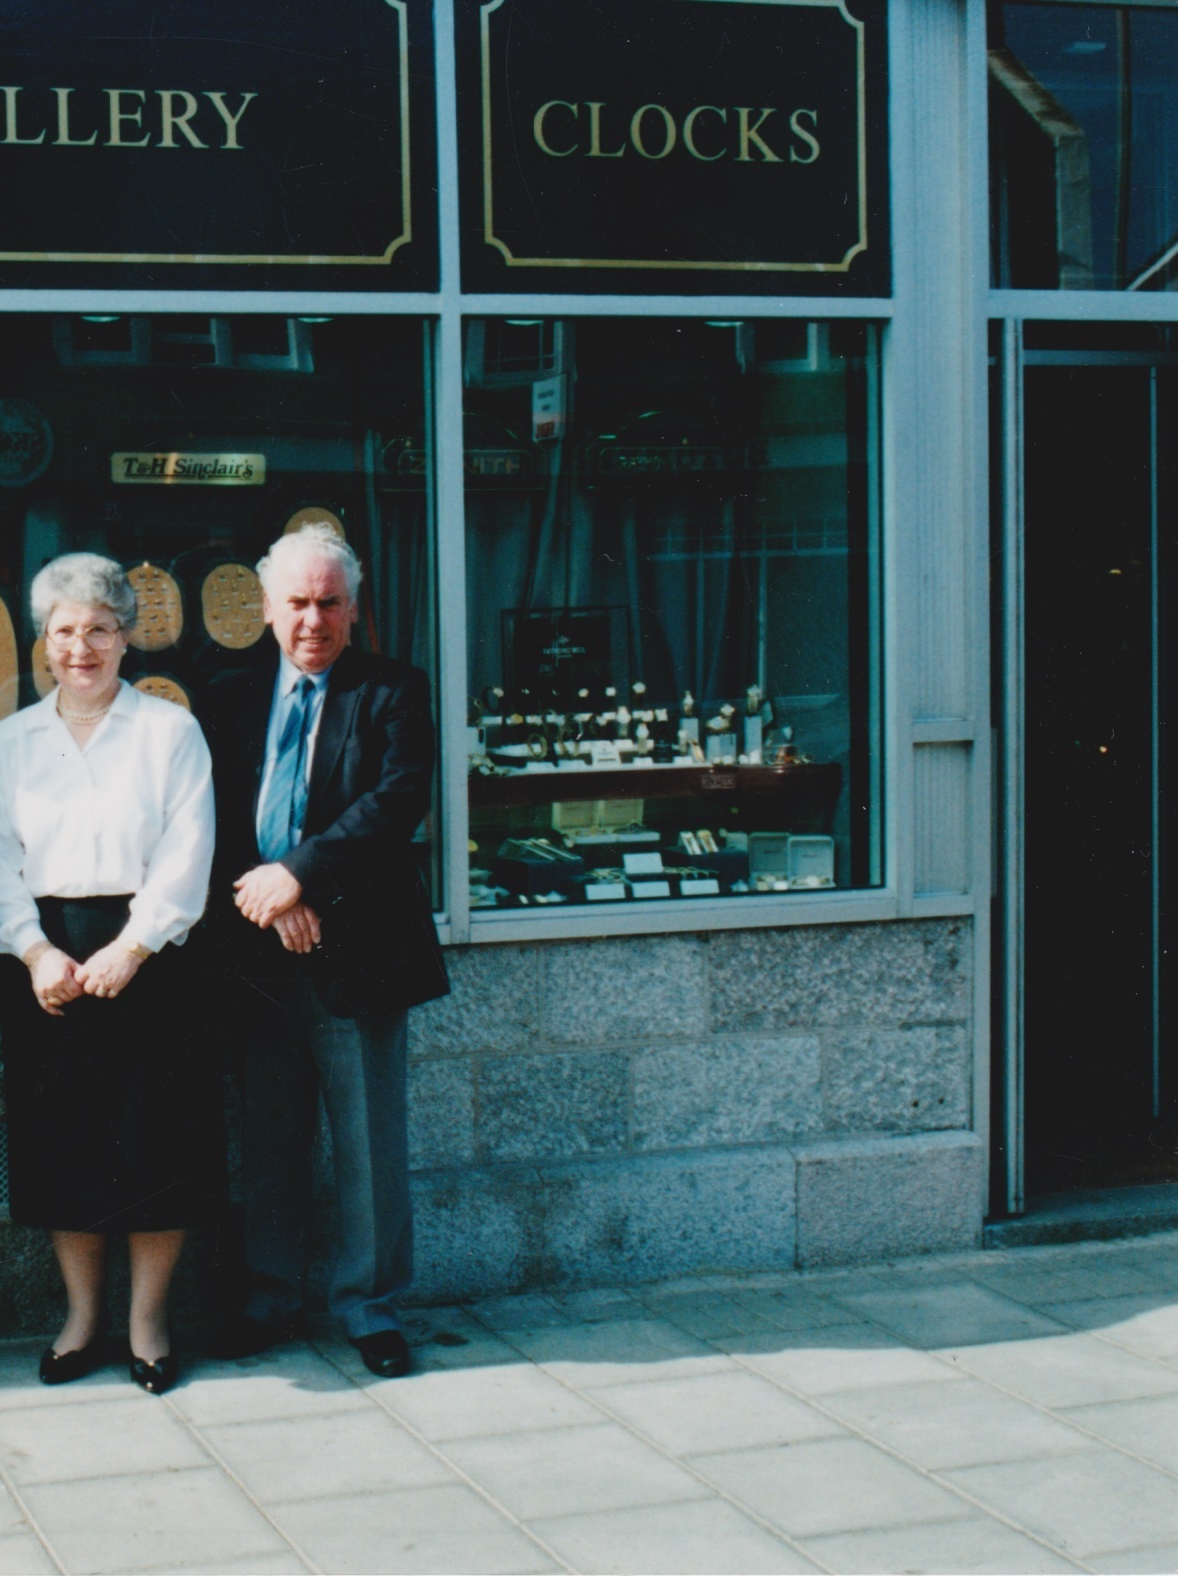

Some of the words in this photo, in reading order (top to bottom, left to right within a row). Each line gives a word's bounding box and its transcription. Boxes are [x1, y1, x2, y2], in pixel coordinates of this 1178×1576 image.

[533, 99, 822, 164] CLOCKS
[123, 458, 168, 476] T&H
[173, 458, 254, 480] Sinclair's
